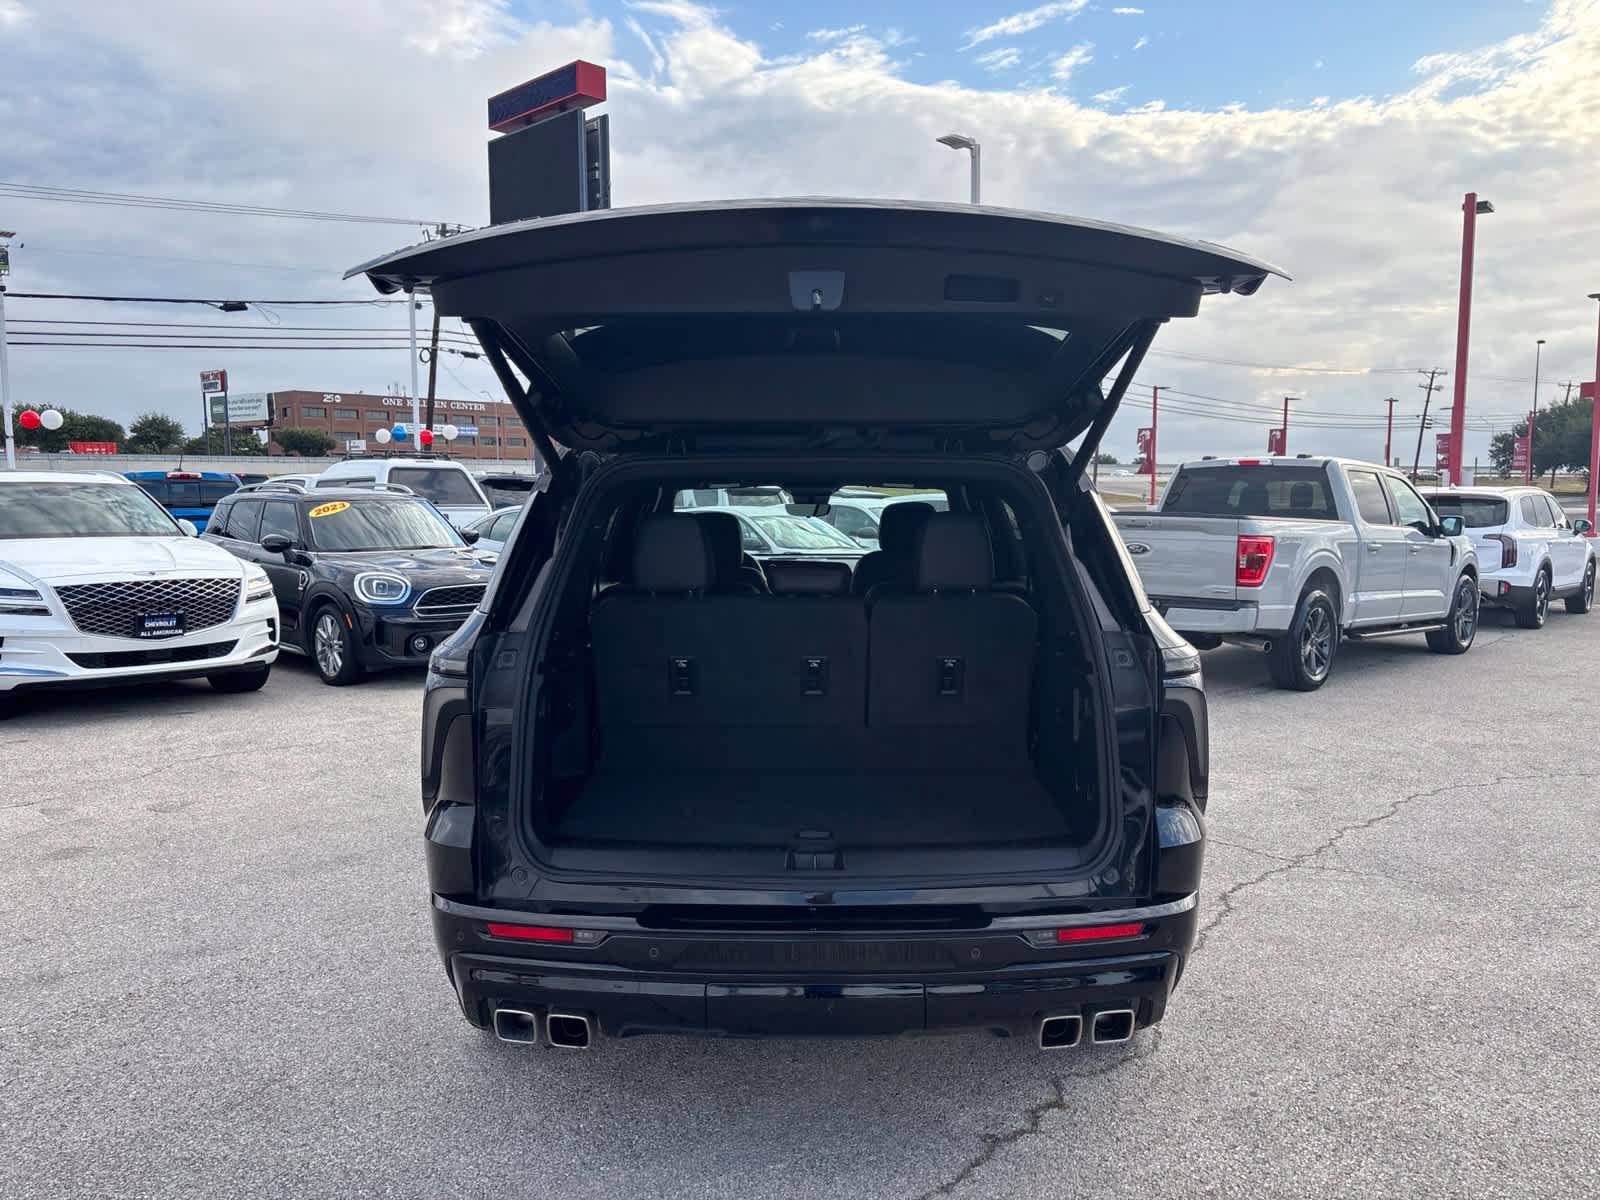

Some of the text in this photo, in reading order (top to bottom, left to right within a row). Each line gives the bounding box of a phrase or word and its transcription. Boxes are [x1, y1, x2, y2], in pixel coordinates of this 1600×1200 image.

[382, 398, 403, 406] ONE
[450, 401, 486, 411] CENTER
[314, 503, 346, 515] 2023
